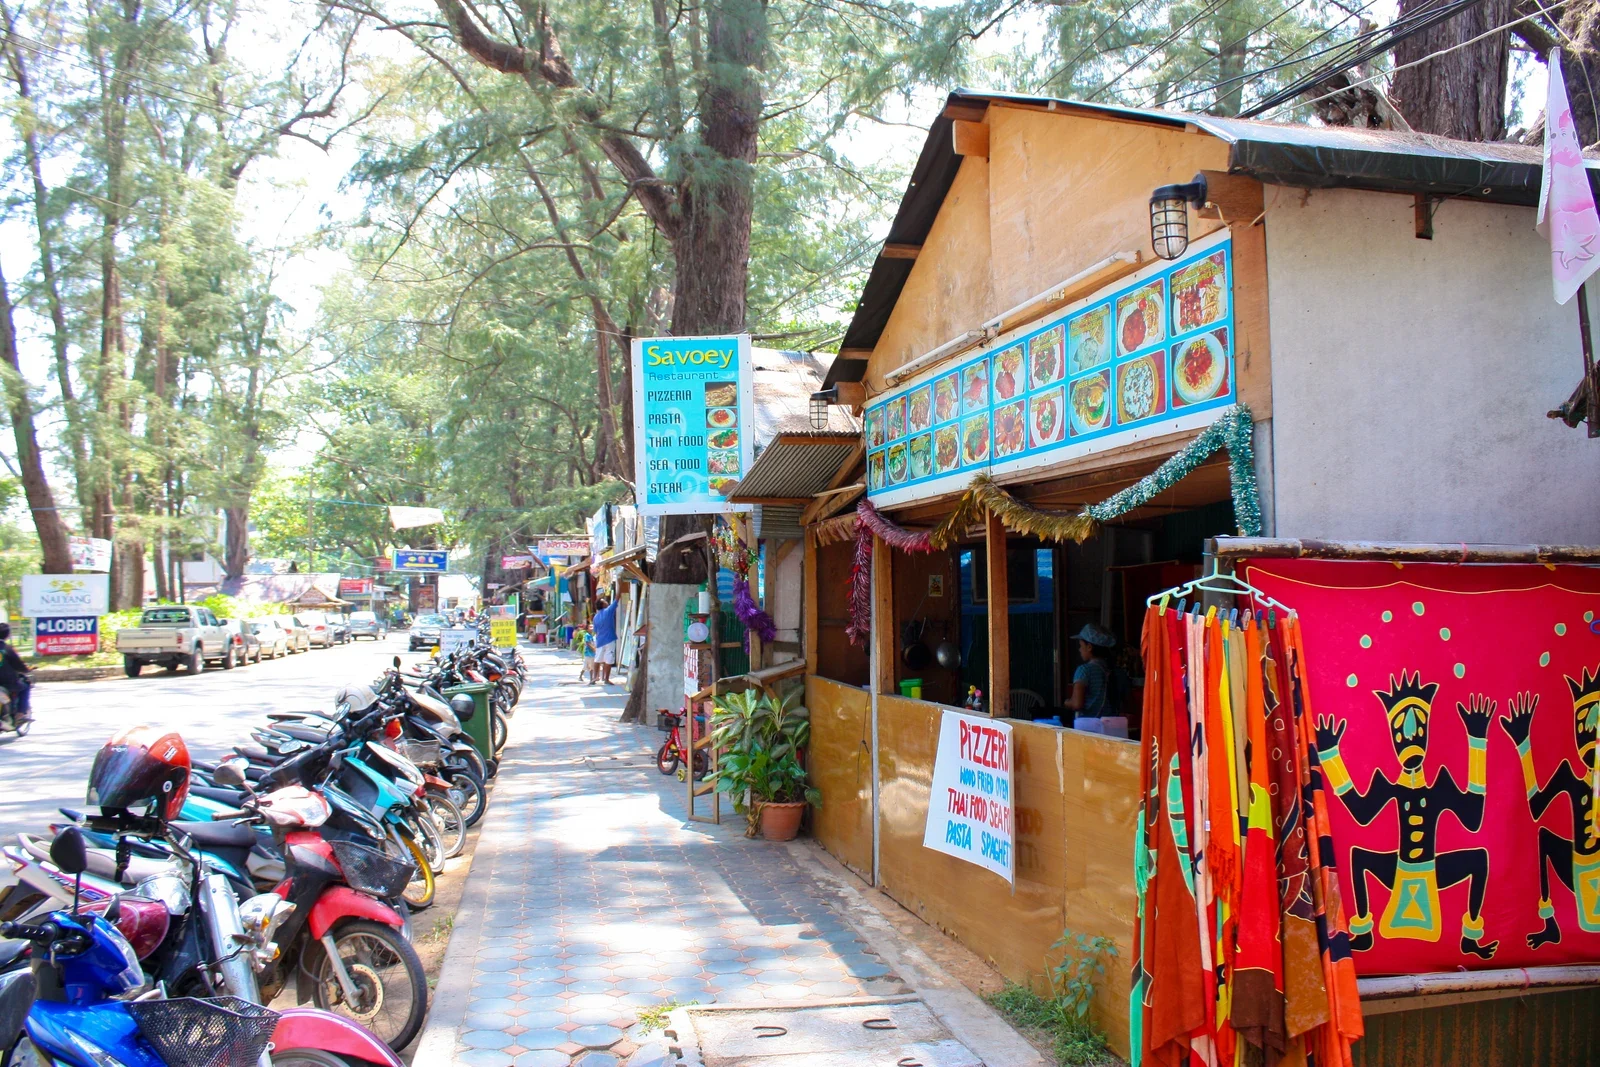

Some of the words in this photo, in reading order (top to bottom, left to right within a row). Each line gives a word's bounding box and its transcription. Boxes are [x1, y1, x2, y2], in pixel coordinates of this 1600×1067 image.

[1189, 339, 1207, 350] PASTA
[647, 345, 734, 369] Savoey
[649, 371, 719, 381] Restaurant
[648, 390, 692, 401] PIZZERIA
[648, 413, 681, 424] PASTA
[649, 436, 672, 448] THAI
[678, 435, 704, 447] FOOD
[650, 459, 669, 470] SEA
[675, 458, 700, 470] FOOD
[650, 482, 683, 493] STEAK
[47, 619, 94, 632] LOBBY
[960, 766, 976, 788] WOOD
[970, 794, 988, 823] FOOD
[945, 820, 972, 851] PASTA
